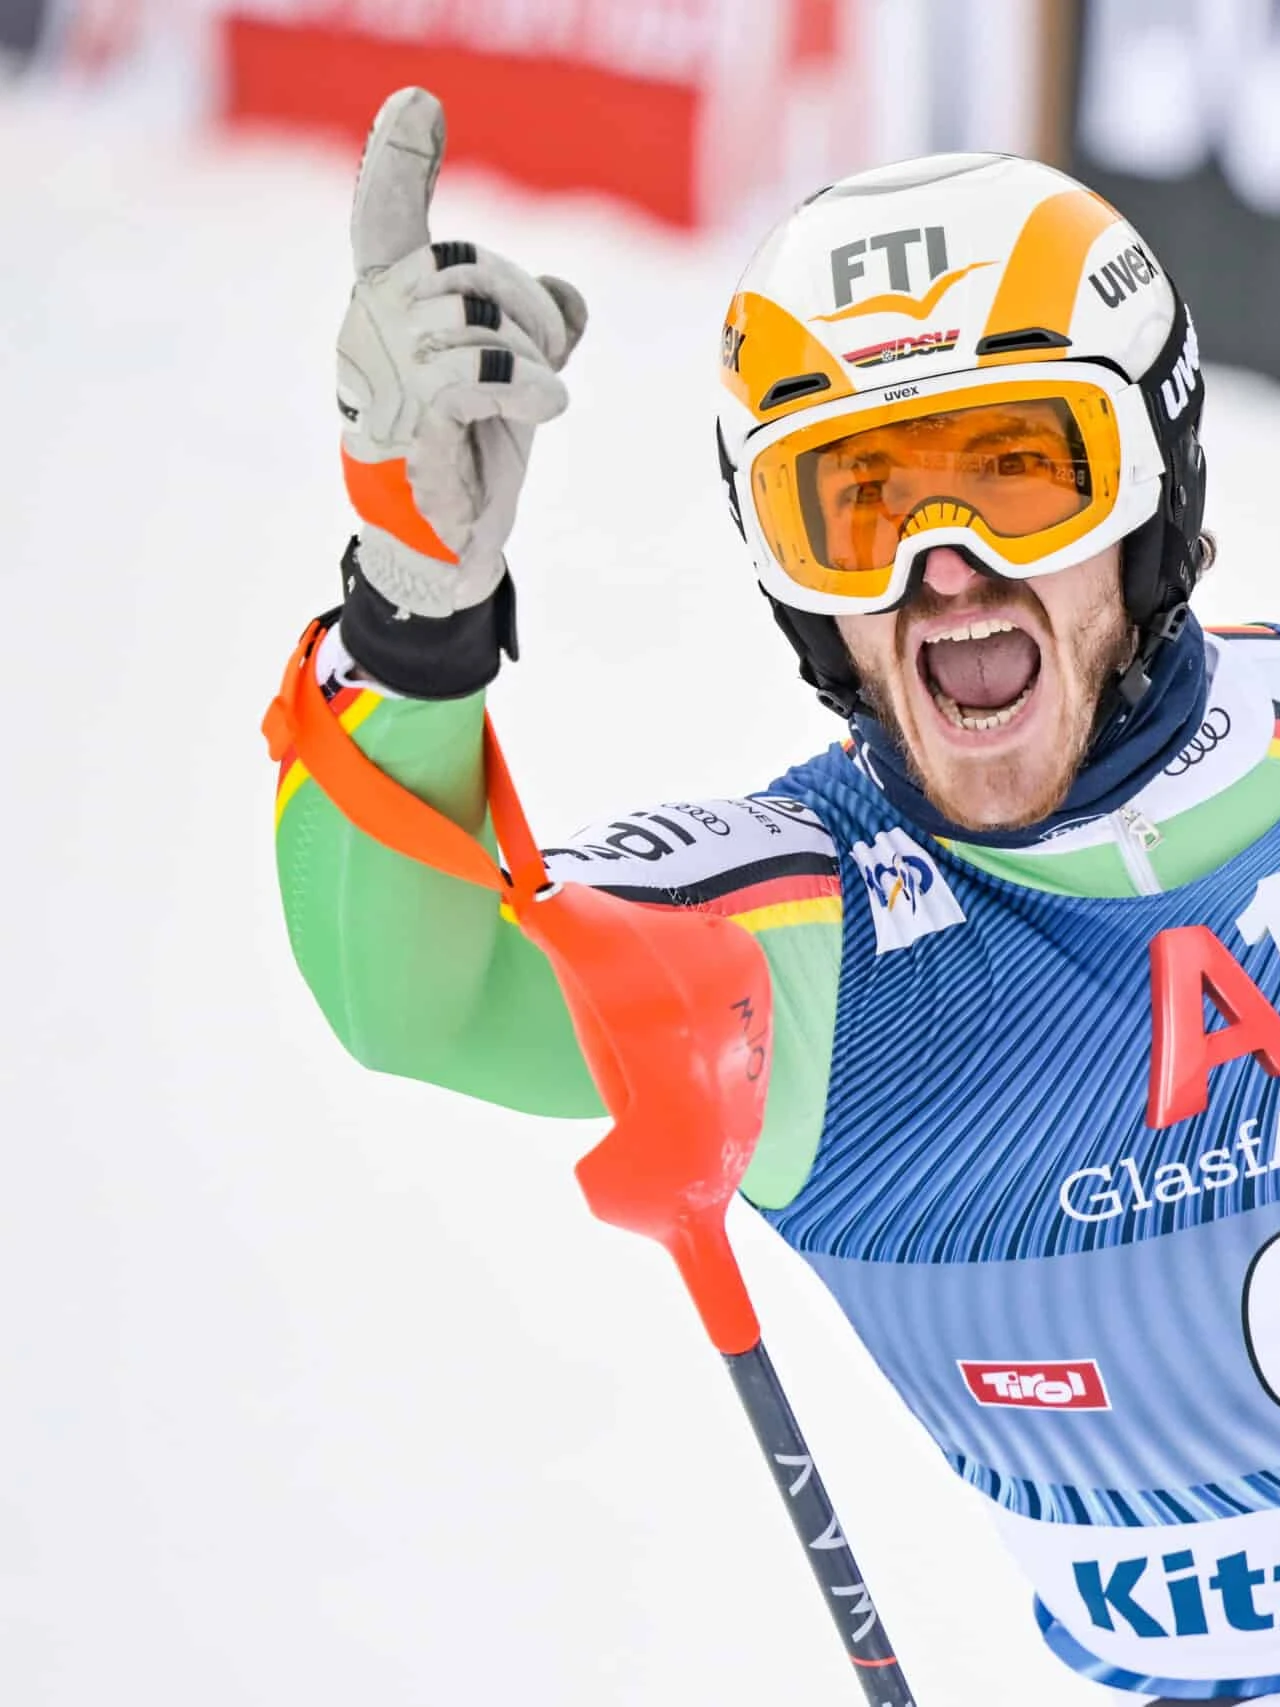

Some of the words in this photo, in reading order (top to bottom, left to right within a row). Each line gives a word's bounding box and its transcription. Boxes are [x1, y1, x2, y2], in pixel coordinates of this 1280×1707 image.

[831, 226, 948, 308] FTI
[1088, 242, 1159, 309] uvex
[884, 385, 920, 402] uvex
[1161, 303, 1201, 421] uv
[981, 1371, 1087, 1404] Tirol
